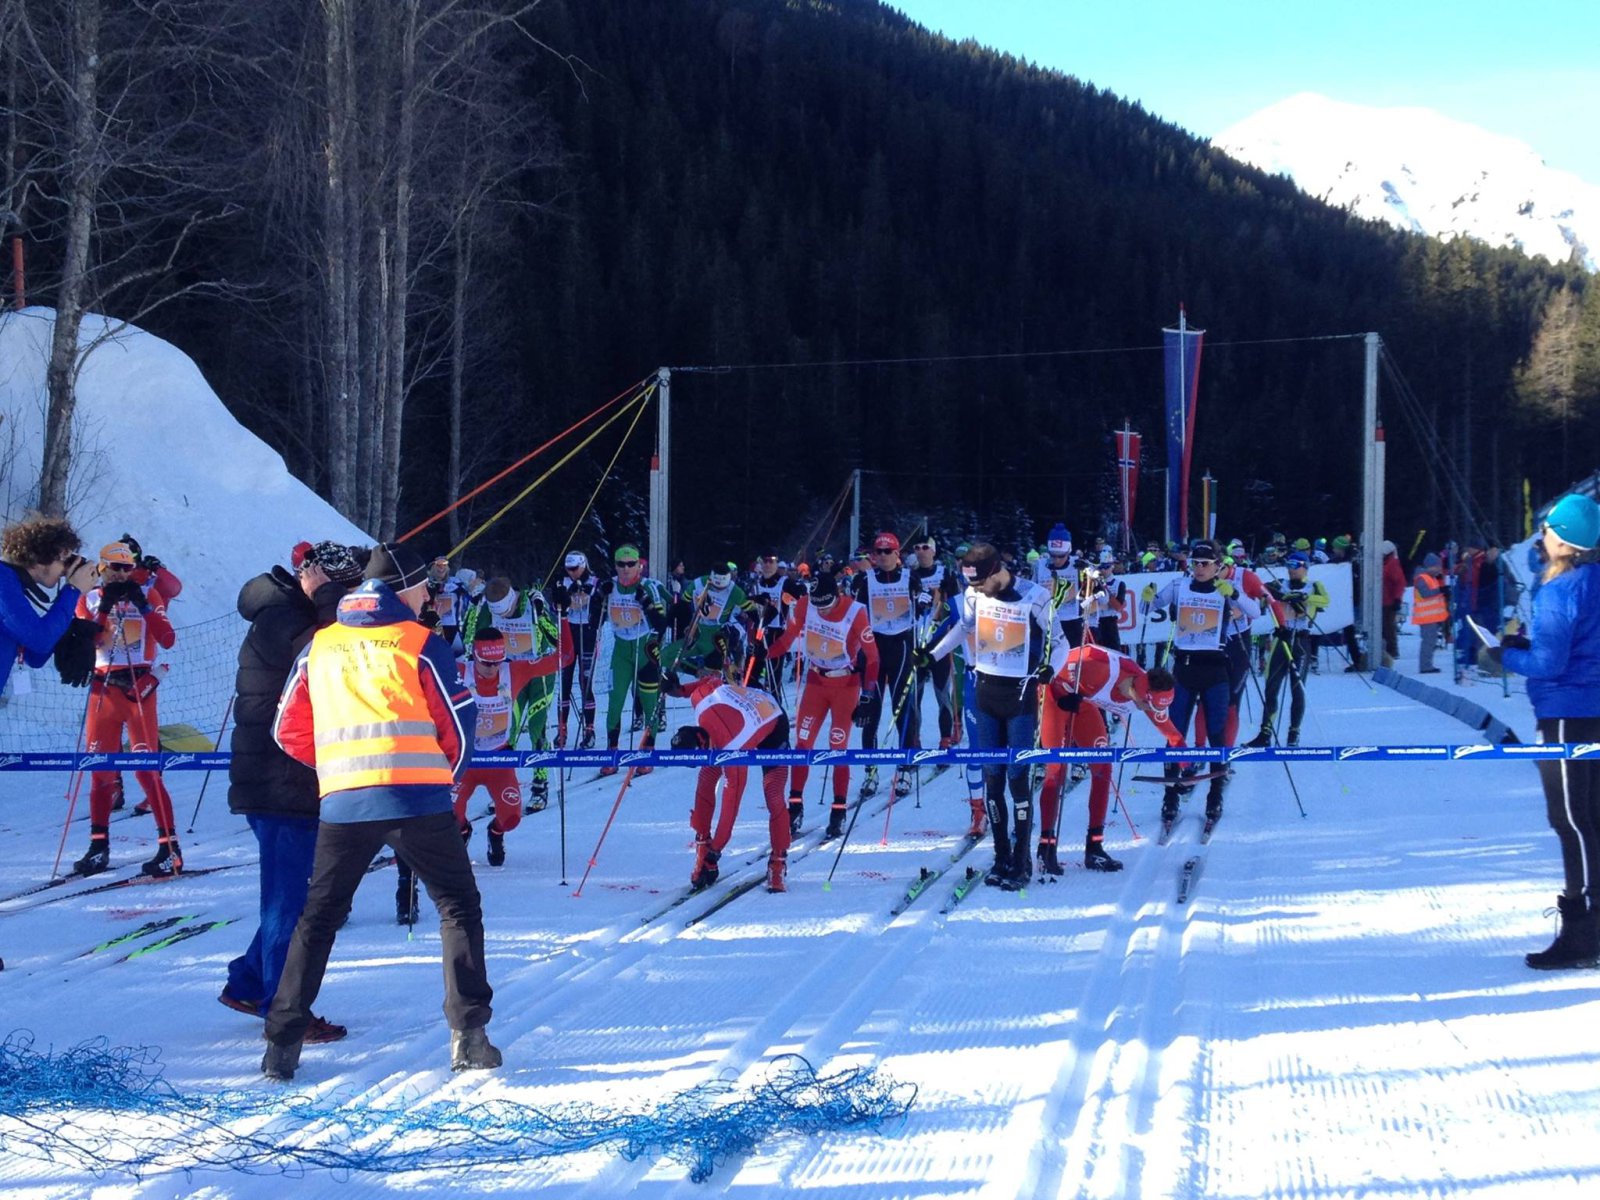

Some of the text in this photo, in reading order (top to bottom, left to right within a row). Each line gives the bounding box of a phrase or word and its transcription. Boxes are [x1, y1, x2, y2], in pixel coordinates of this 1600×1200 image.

[994, 626, 1004, 642] 6
[820, 641, 828, 653] 4
[659, 754, 707, 762] www.osttirol.com
[756, 753, 806, 761] www.osttirol.com
[1059, 750, 1112, 758] www.osttirol.com
[114, 758, 159, 766] www.osttirol.com
[471, 755, 519, 763] www.osttirol.com
[564, 755, 612, 763] www.osttirol.com
